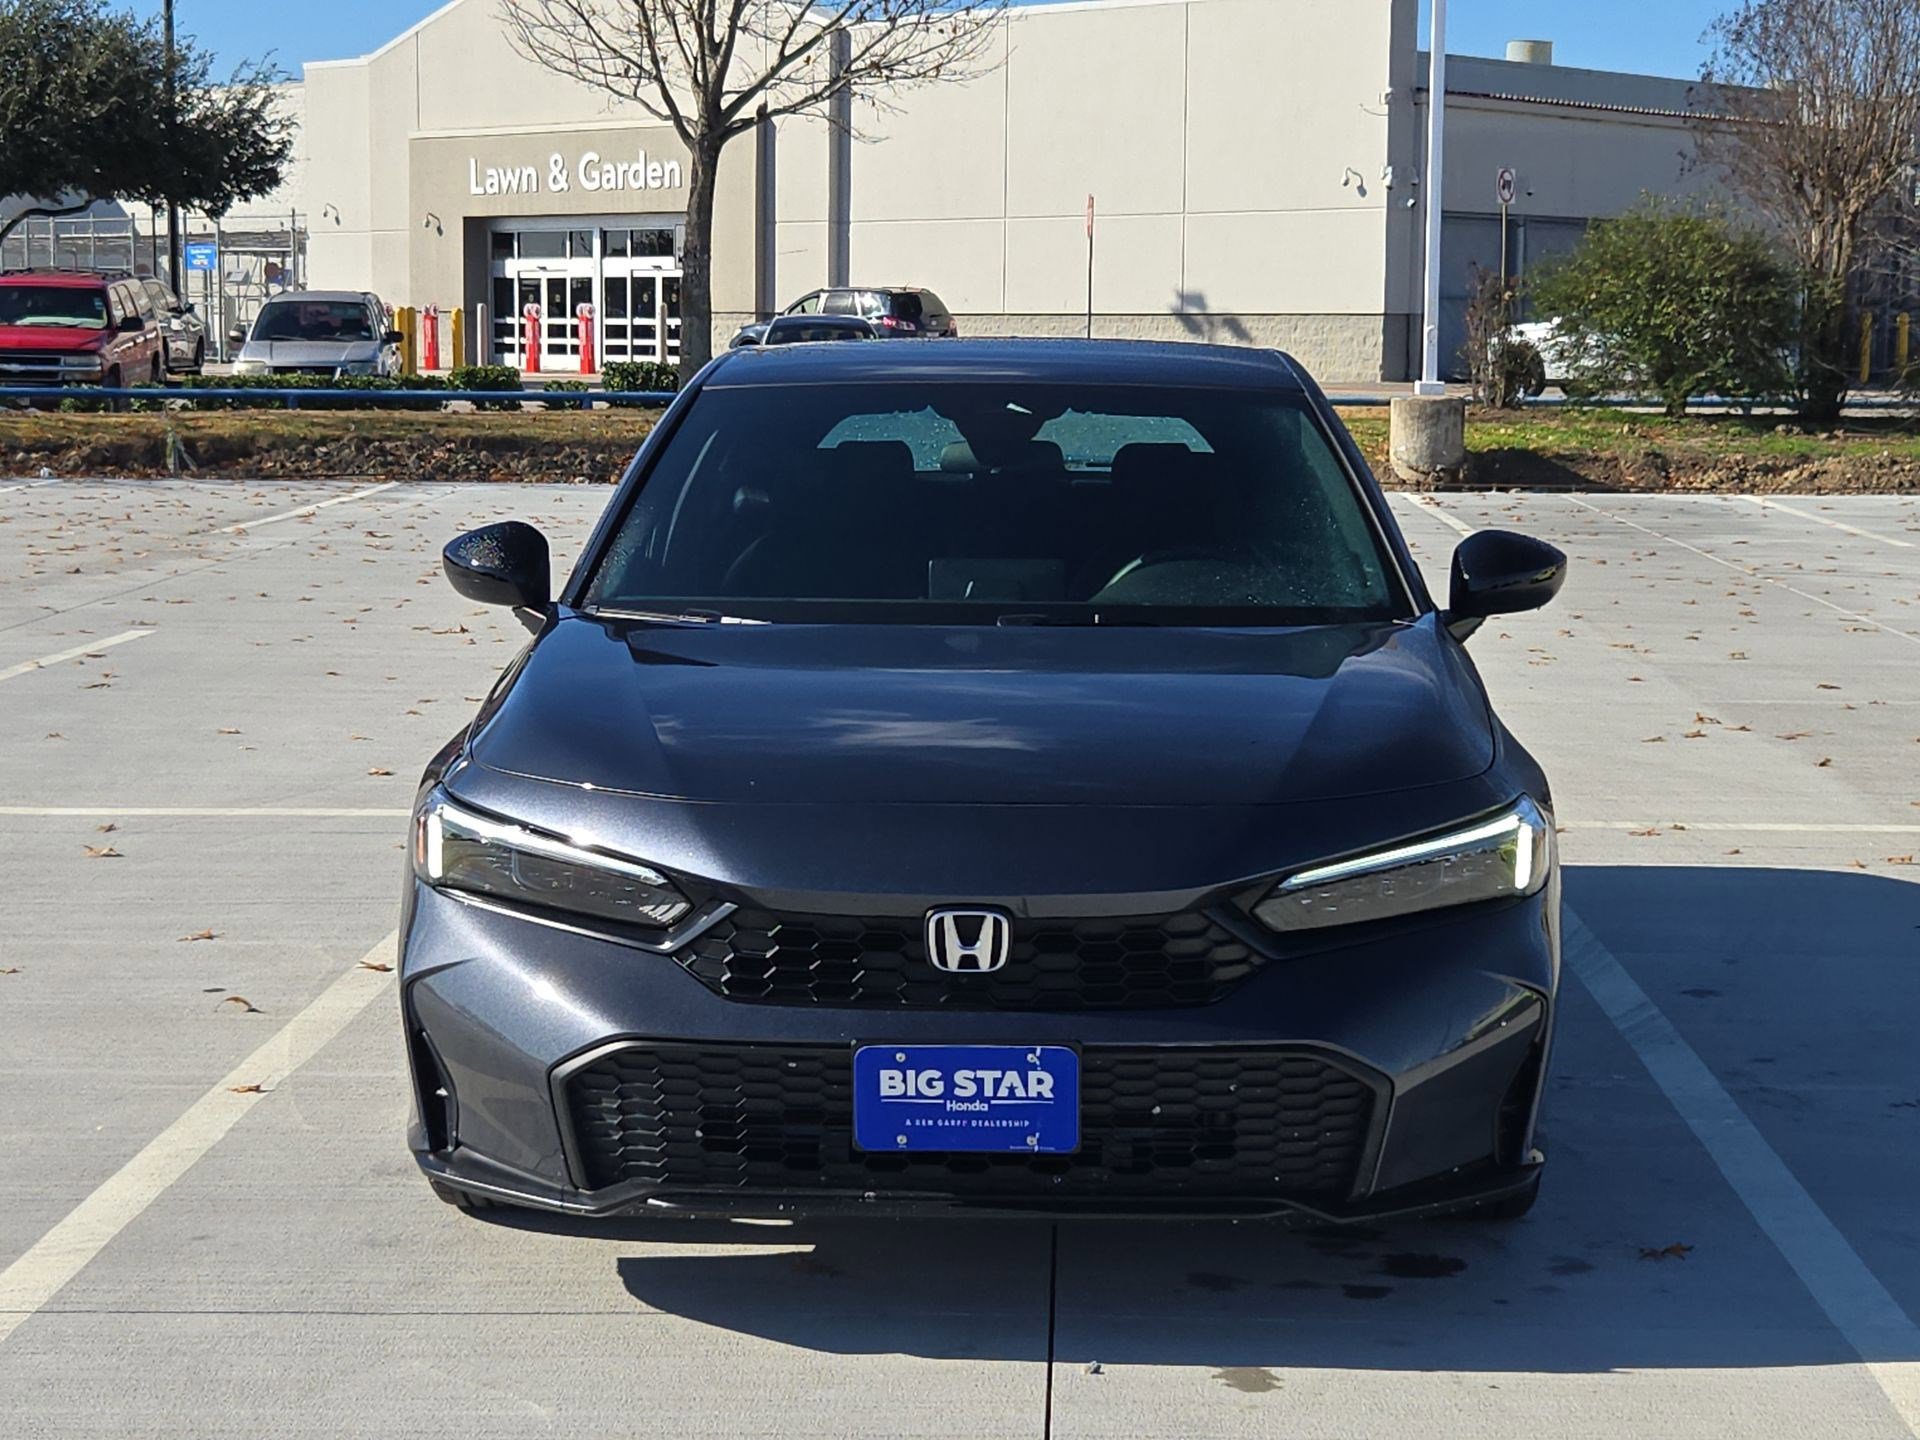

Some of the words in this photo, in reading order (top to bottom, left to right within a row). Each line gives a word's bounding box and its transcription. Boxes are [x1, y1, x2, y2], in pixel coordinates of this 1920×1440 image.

[469, 158, 539, 195] Lawn
[548, 153, 570, 193] &
[578, 150, 683, 191] Garden
[879, 1069, 945, 1097] BIG
[953, 1070, 1054, 1098] STAR
[946, 1100, 988, 1112] Honda
[905, 1118, 912, 1127] A
[971, 1119, 1030, 1128] DEALERSHIP
